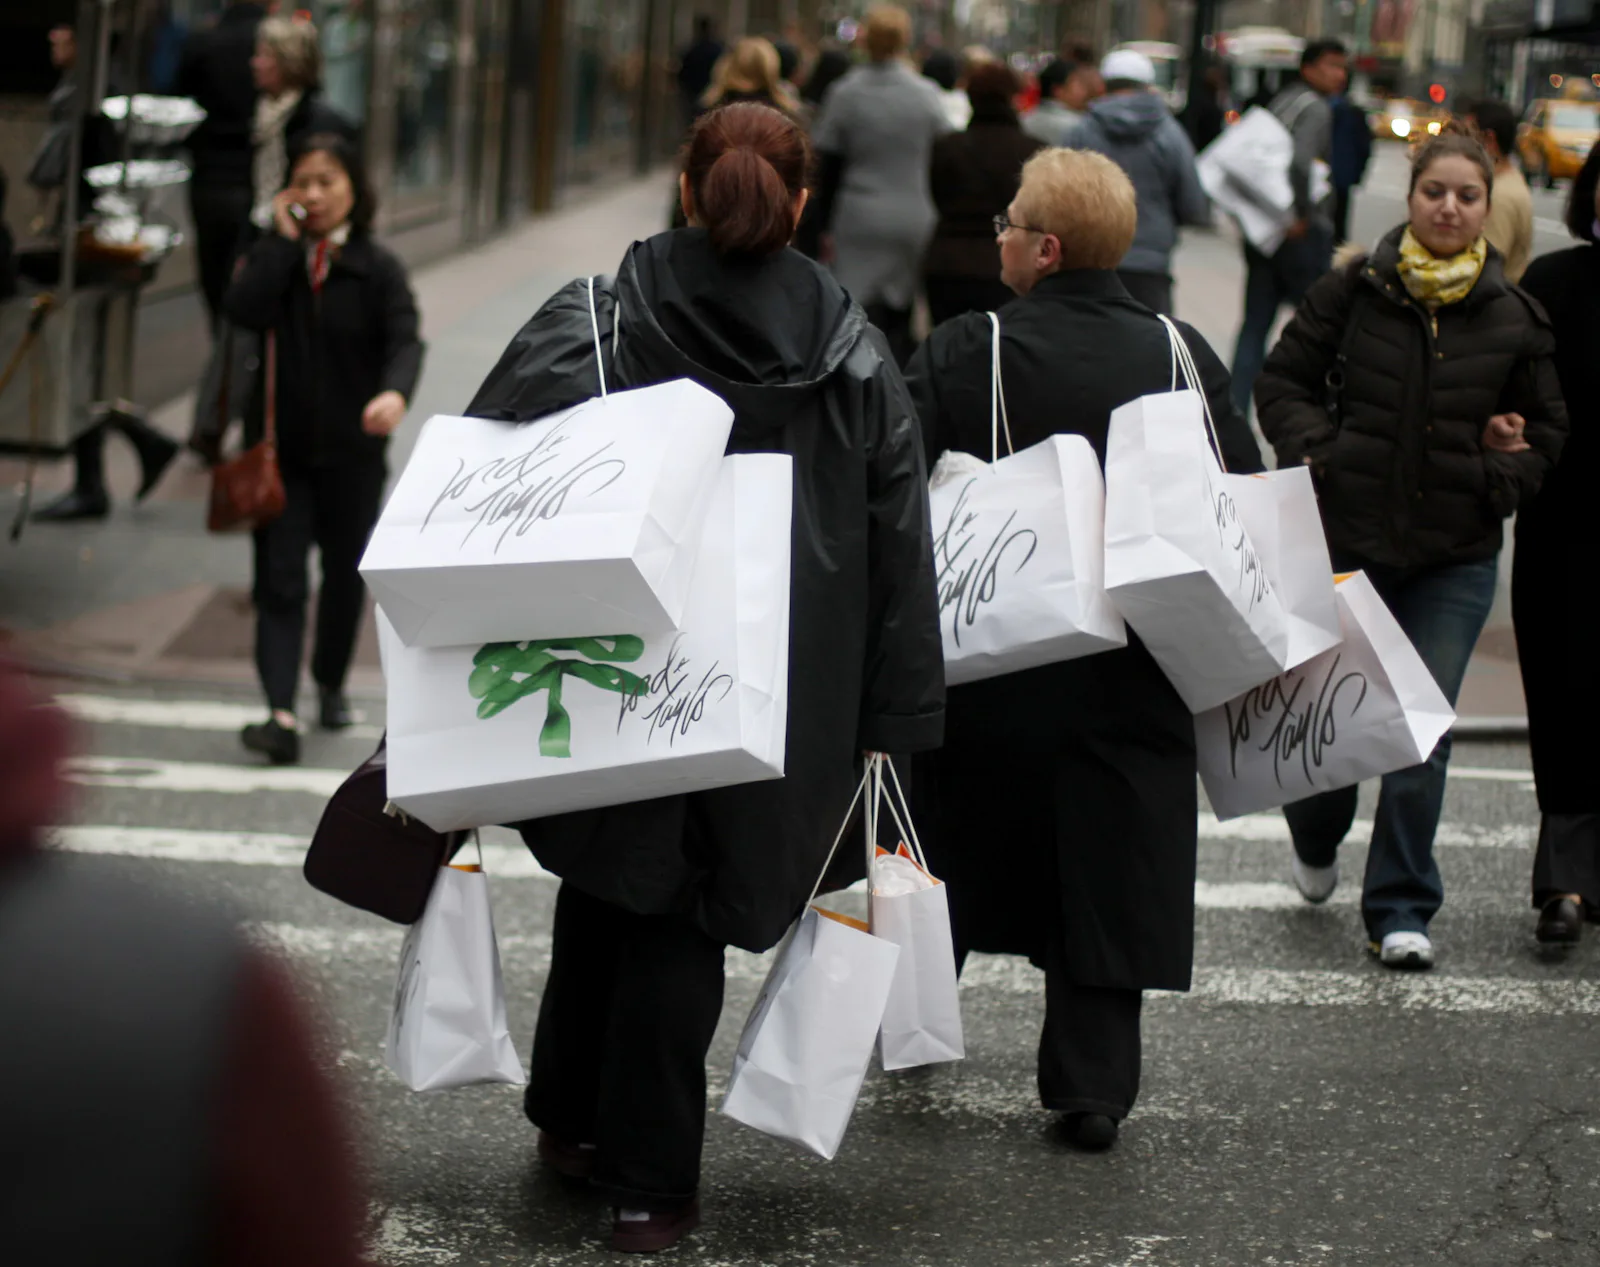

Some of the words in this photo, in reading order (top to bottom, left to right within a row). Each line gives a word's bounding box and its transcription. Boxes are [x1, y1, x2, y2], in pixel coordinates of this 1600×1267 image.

[420, 409, 584, 534] Lord
[459, 440, 626, 556] Taylor
[616, 631, 689, 736] Lord
[641, 659, 734, 749] Taylor
[1258, 652, 1368, 789] Taylor
